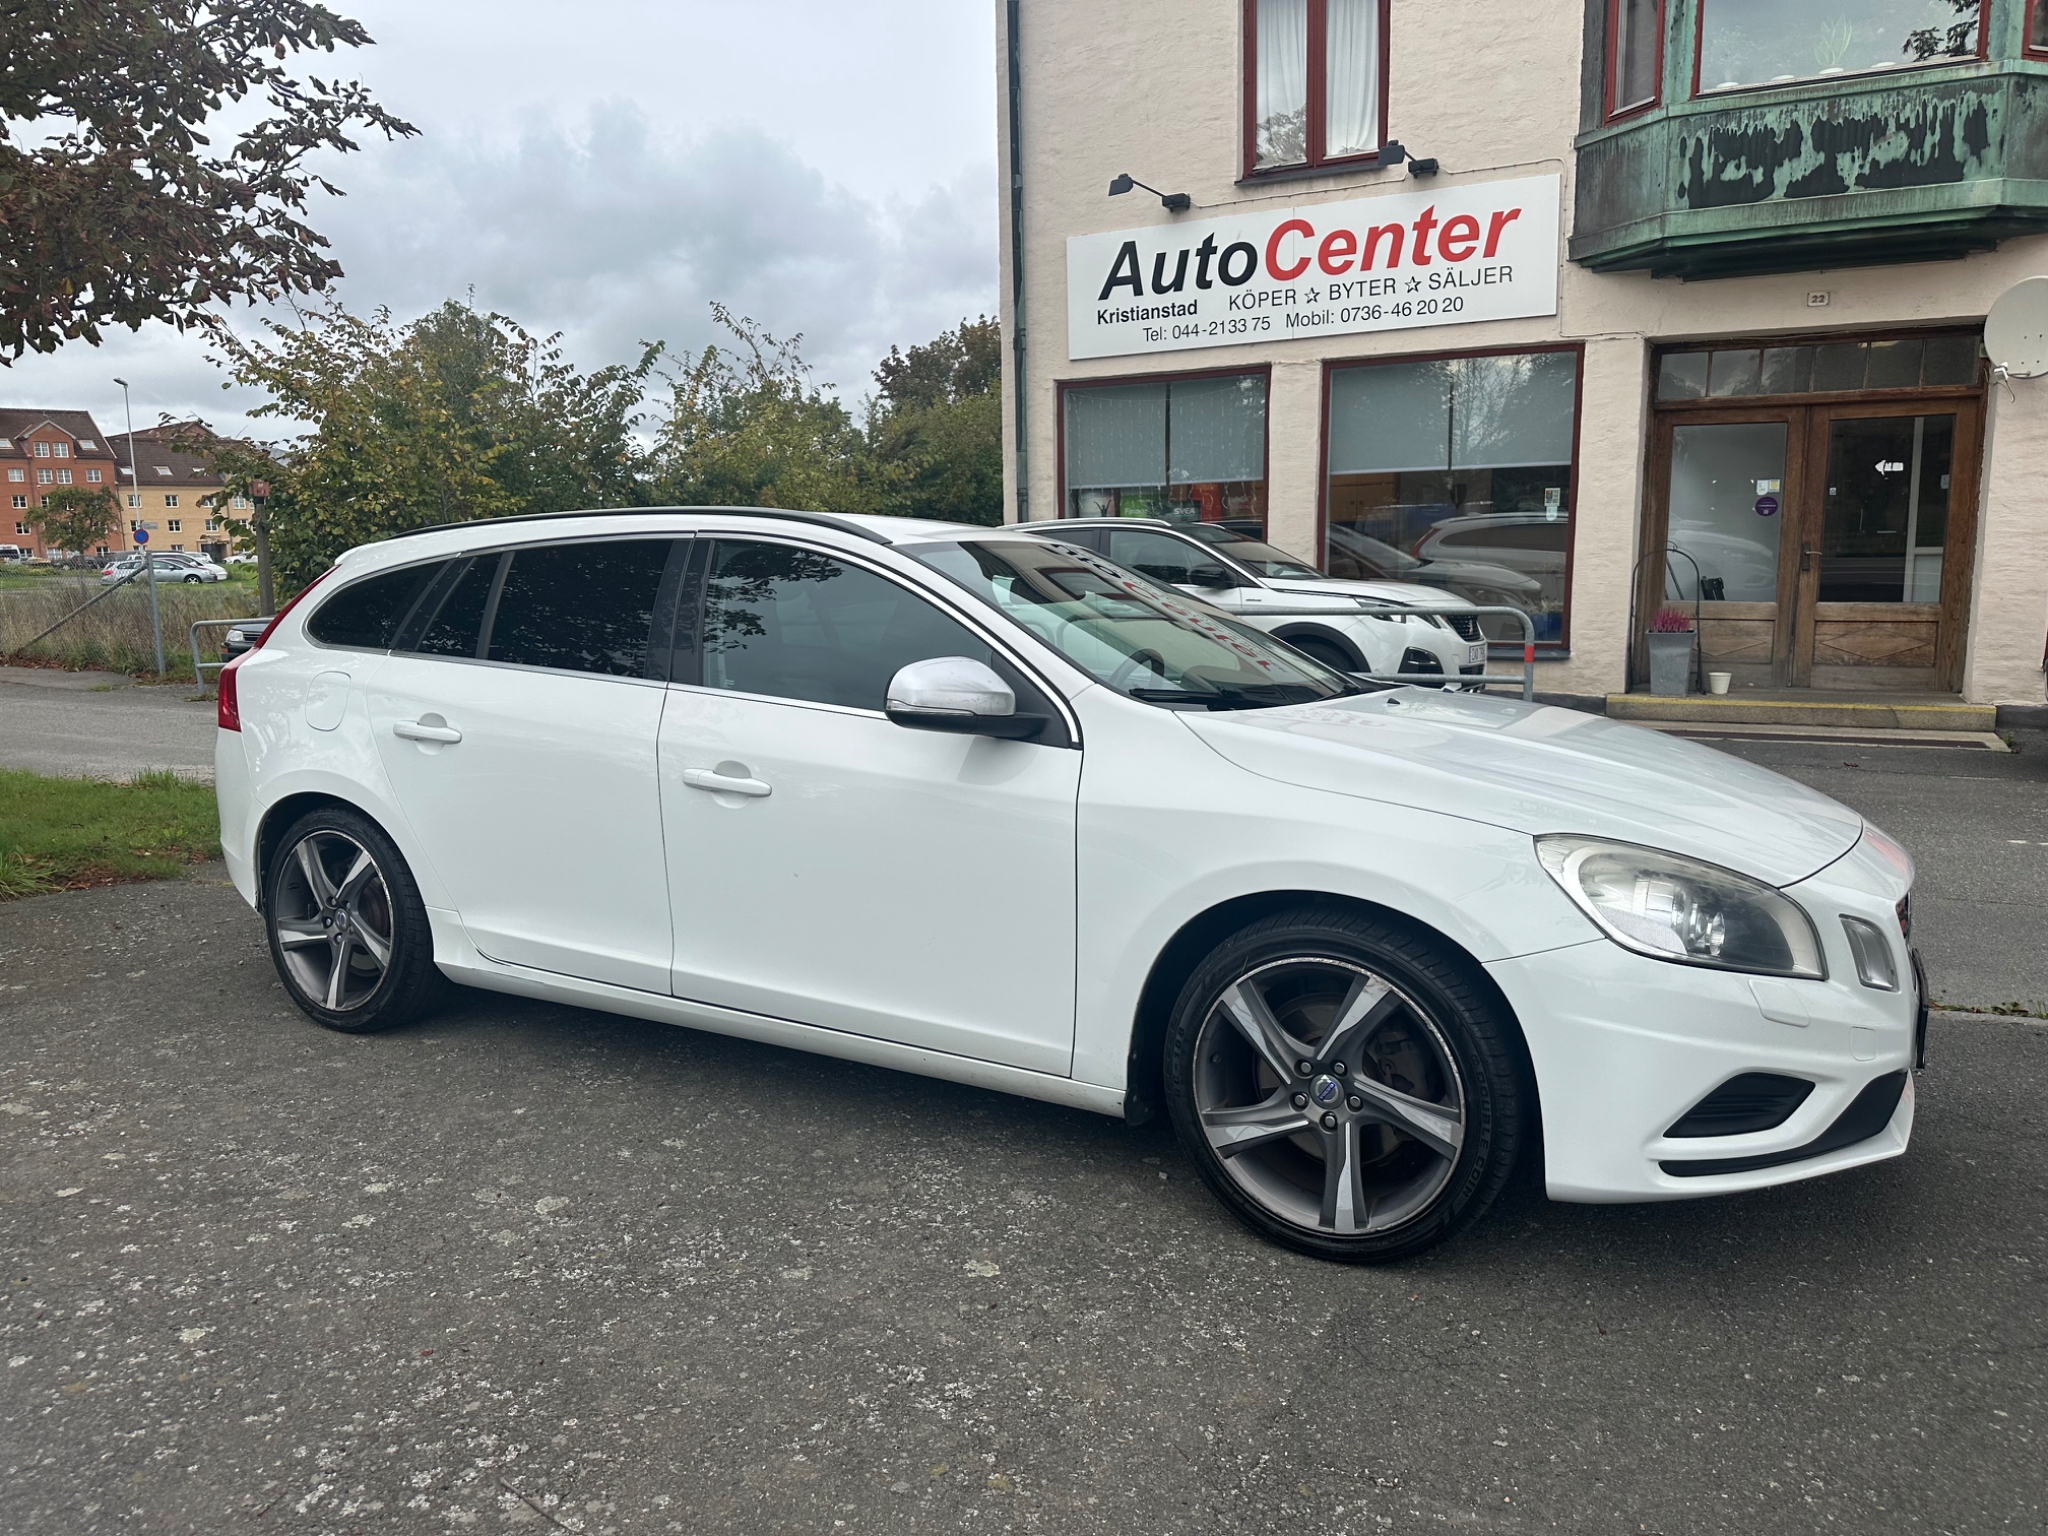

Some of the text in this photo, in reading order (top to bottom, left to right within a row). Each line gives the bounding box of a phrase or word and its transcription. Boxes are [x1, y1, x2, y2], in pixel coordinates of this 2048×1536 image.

[1097, 204, 1522, 301] AutoCenter
[1228, 265, 1513, 311] KÖPER BYTER SÄLJER
[1811, 294, 1825, 303] 22
[1096, 299, 1198, 325] Kristianstad
[1142, 326, 1167, 342] Tel:
[1285, 309, 1335, 328] Mobil:
[1340, 301, 1412, 323] 0736-46
[1416, 298, 1438, 316] 20
[1442, 296, 1464, 313] 20
